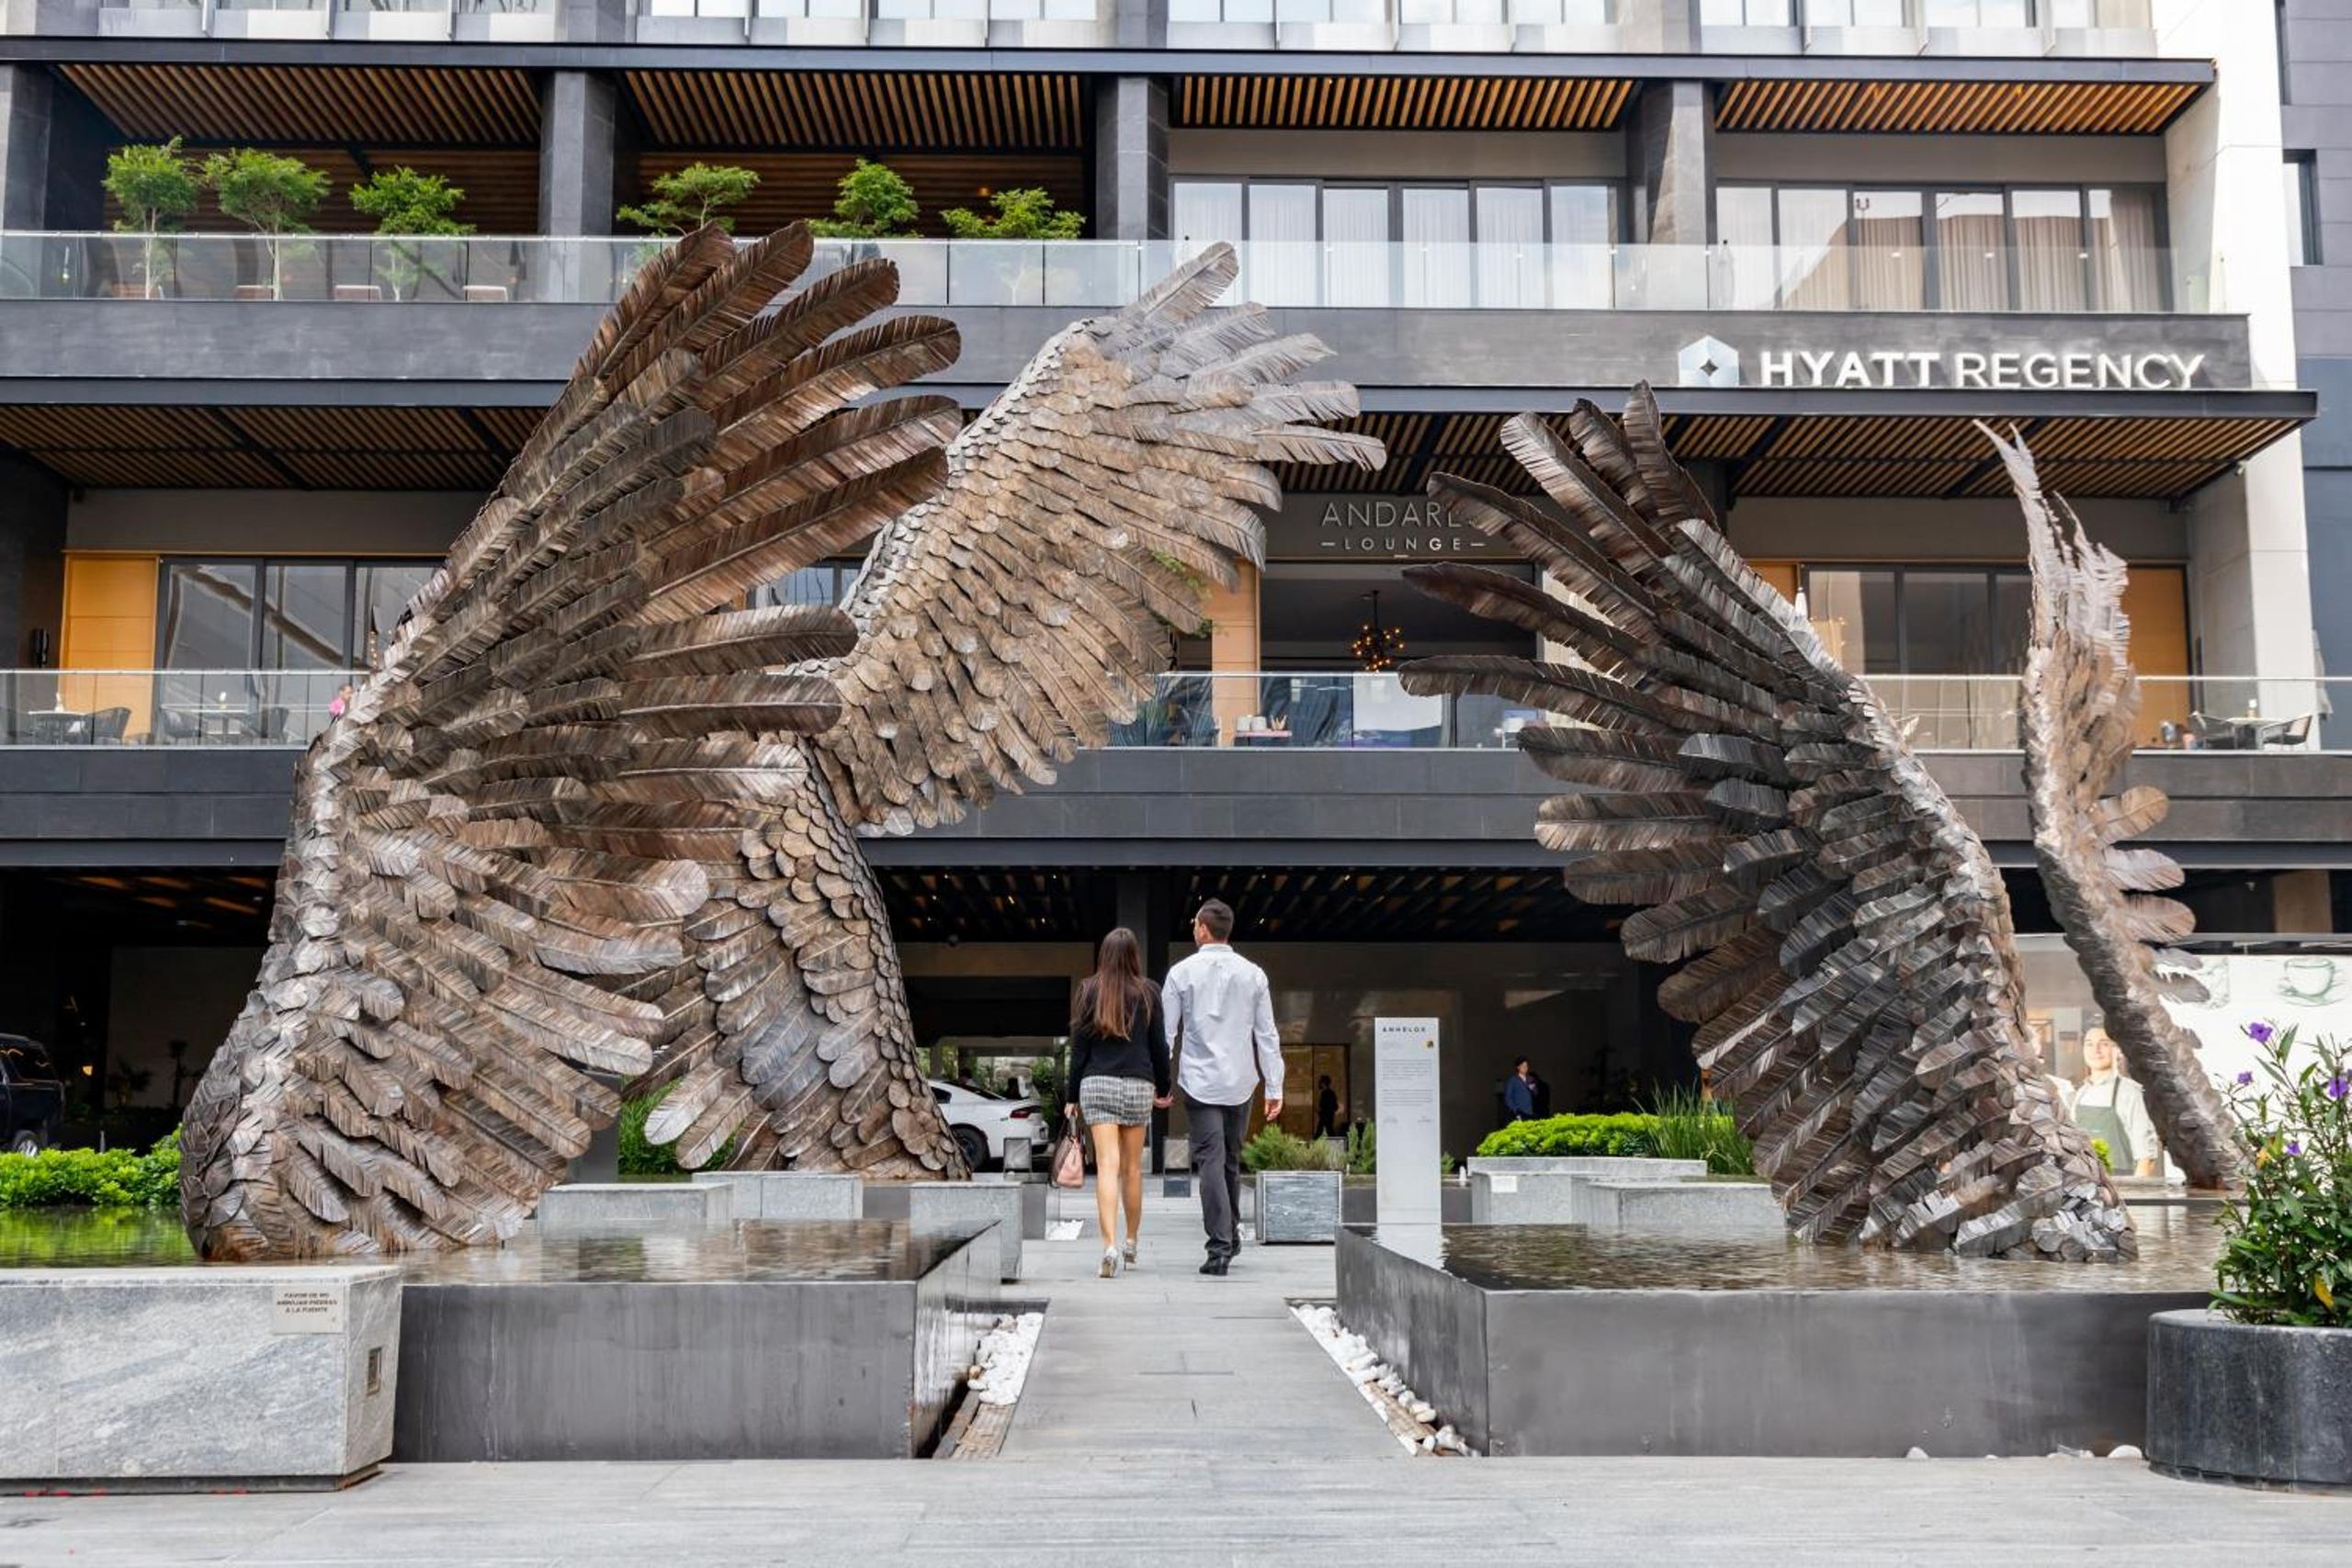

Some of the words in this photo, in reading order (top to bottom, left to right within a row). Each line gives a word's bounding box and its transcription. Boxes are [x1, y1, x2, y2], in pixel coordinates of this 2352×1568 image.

[1759, 350, 1941, 388] HYATT
[1953, 352, 2205, 389] REGENCY
[1344, 537, 1462, 551] LOUNGE
